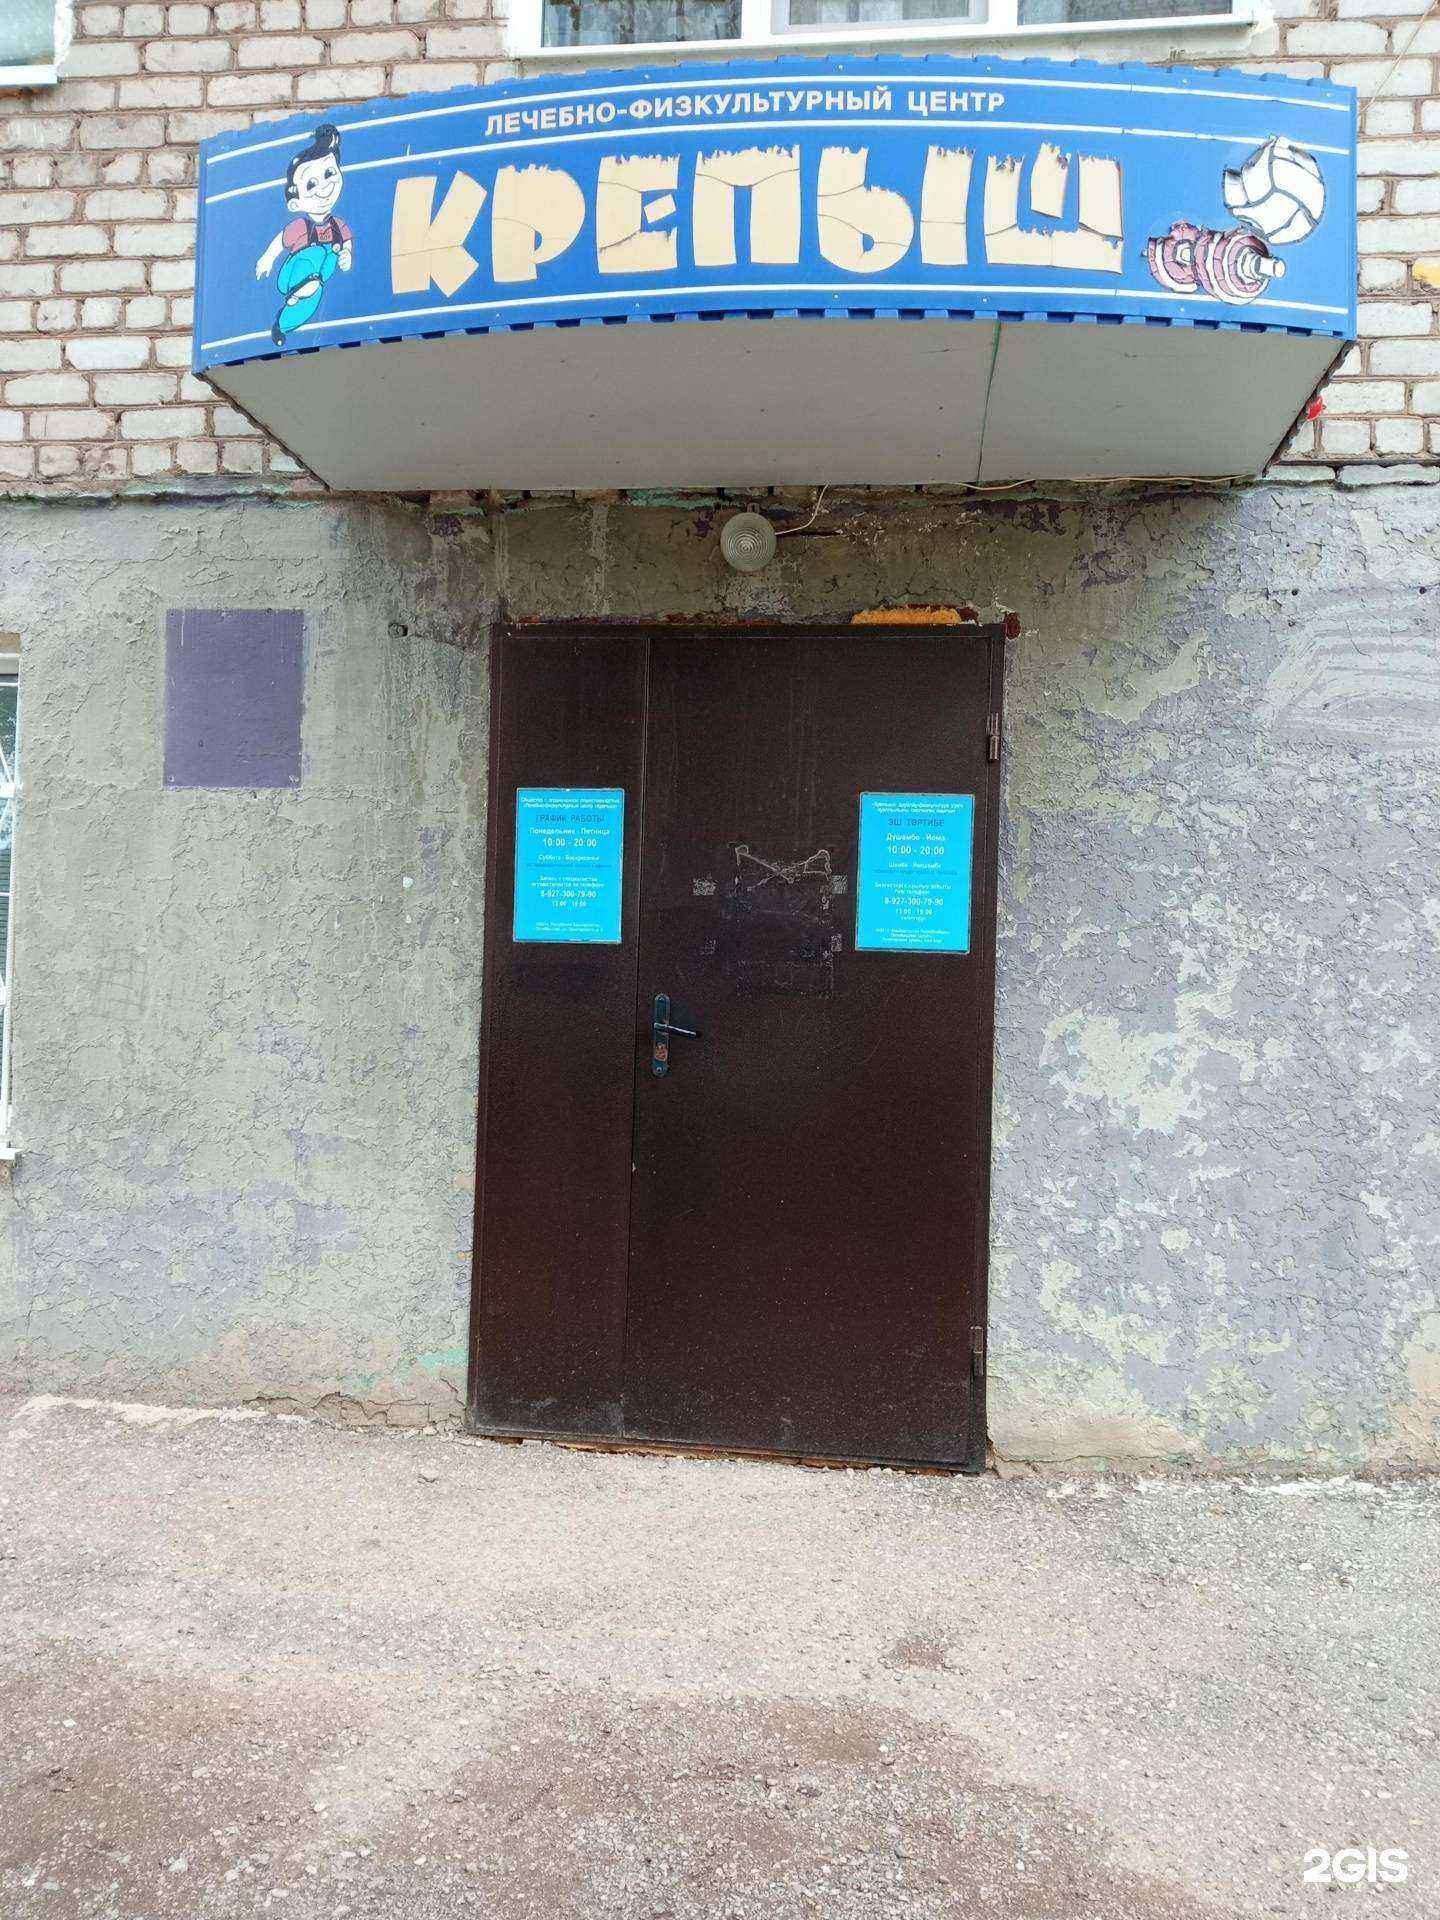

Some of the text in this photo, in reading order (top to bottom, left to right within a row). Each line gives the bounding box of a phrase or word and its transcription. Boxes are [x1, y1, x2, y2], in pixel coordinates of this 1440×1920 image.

[484, 85, 1005, 137] ЛЕЧЕБНО-ФИЗКУЛЬТУРНЫЙ ЦЕНТР
[391, 142, 1125, 298] КРЕПЫШ
